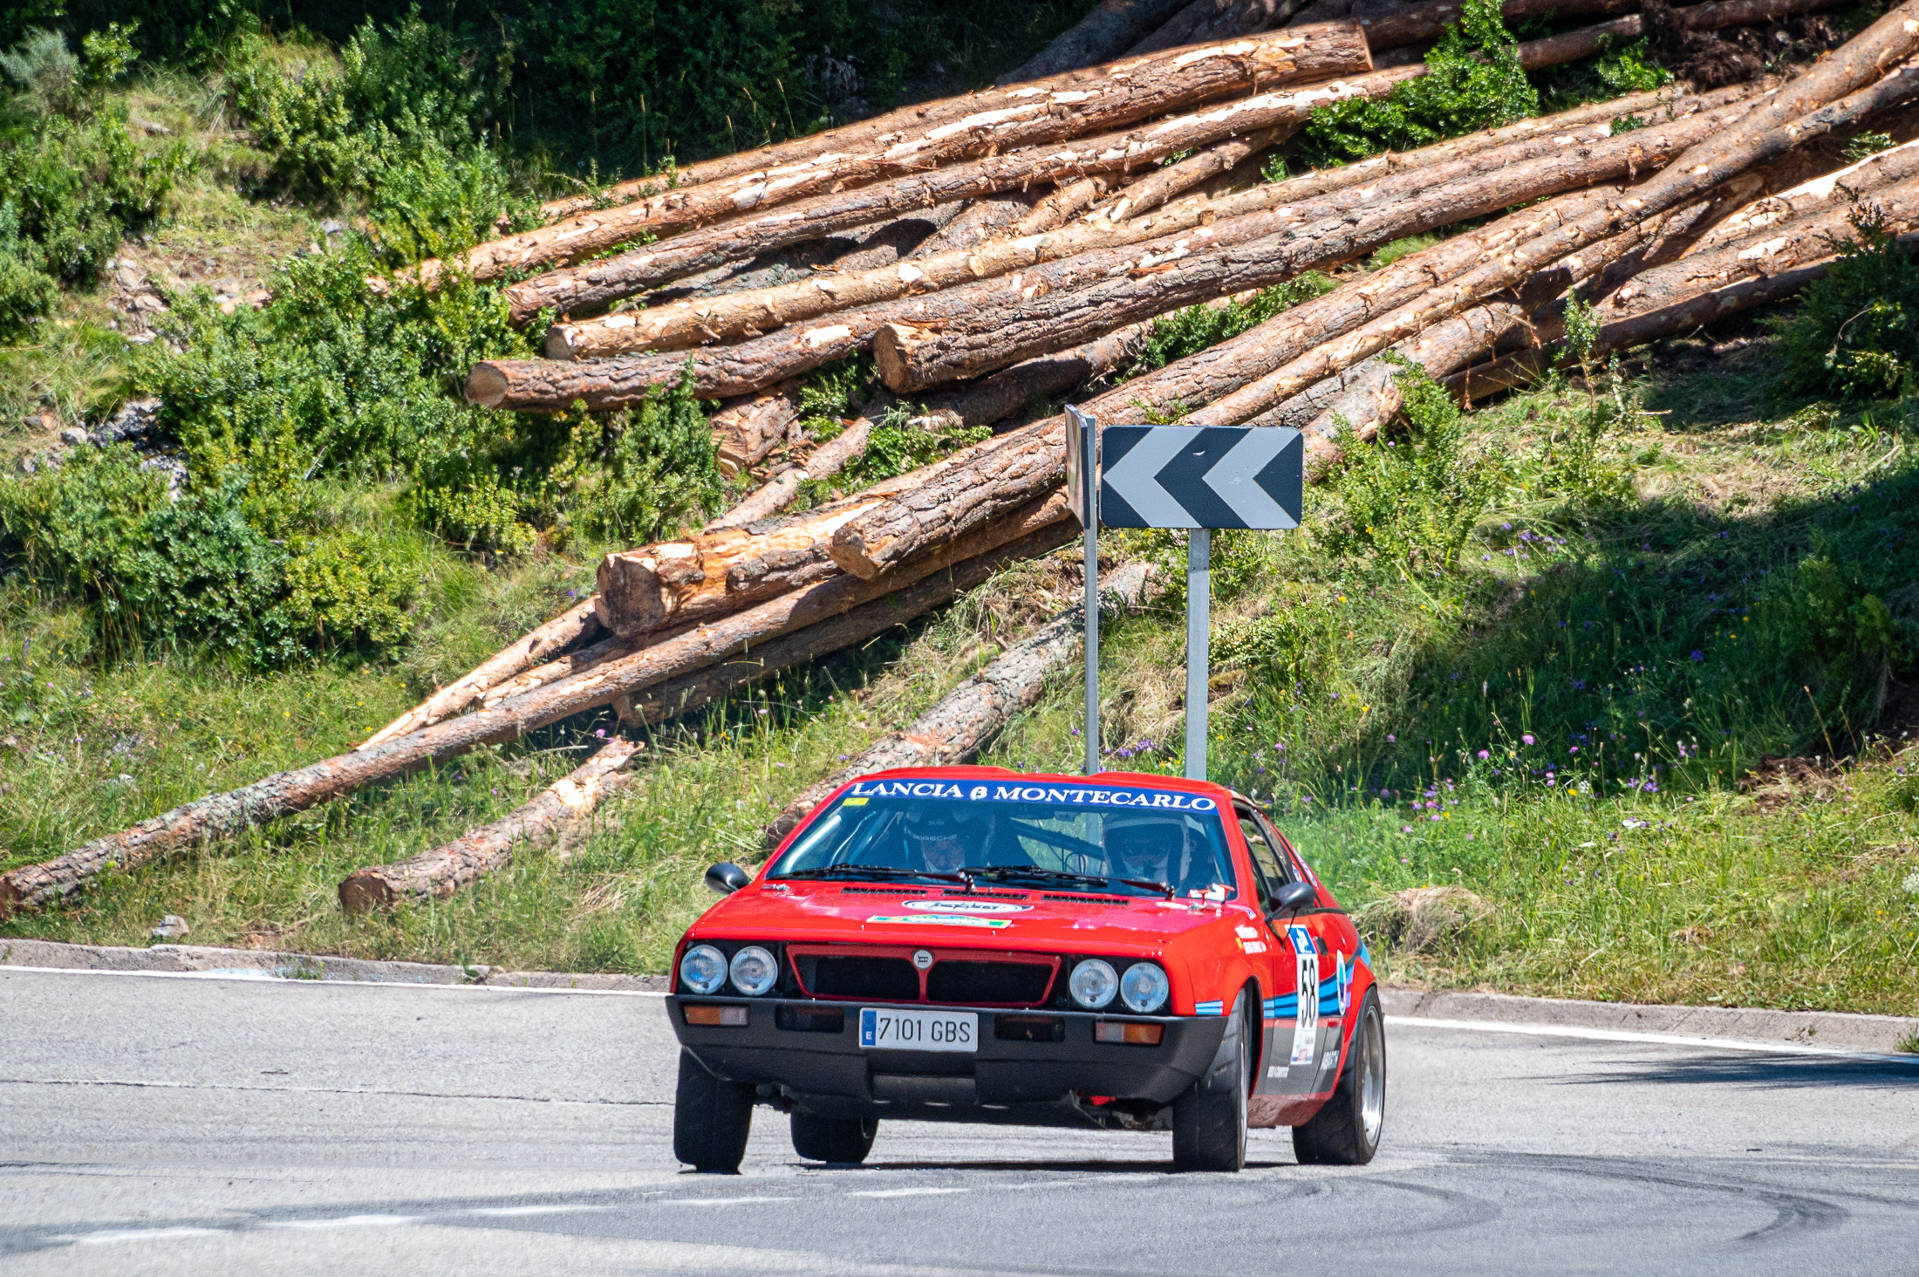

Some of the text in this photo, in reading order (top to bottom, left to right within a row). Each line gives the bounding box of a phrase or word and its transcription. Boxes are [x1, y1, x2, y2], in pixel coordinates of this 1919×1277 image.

[851, 782, 964, 798] LANCIA
[993, 786, 1217, 811] MONTECARLO
[1301, 958, 1316, 1029] 58
[865, 1031, 873, 1041] E
[879, 1017, 971, 1043] 7101 GBS
